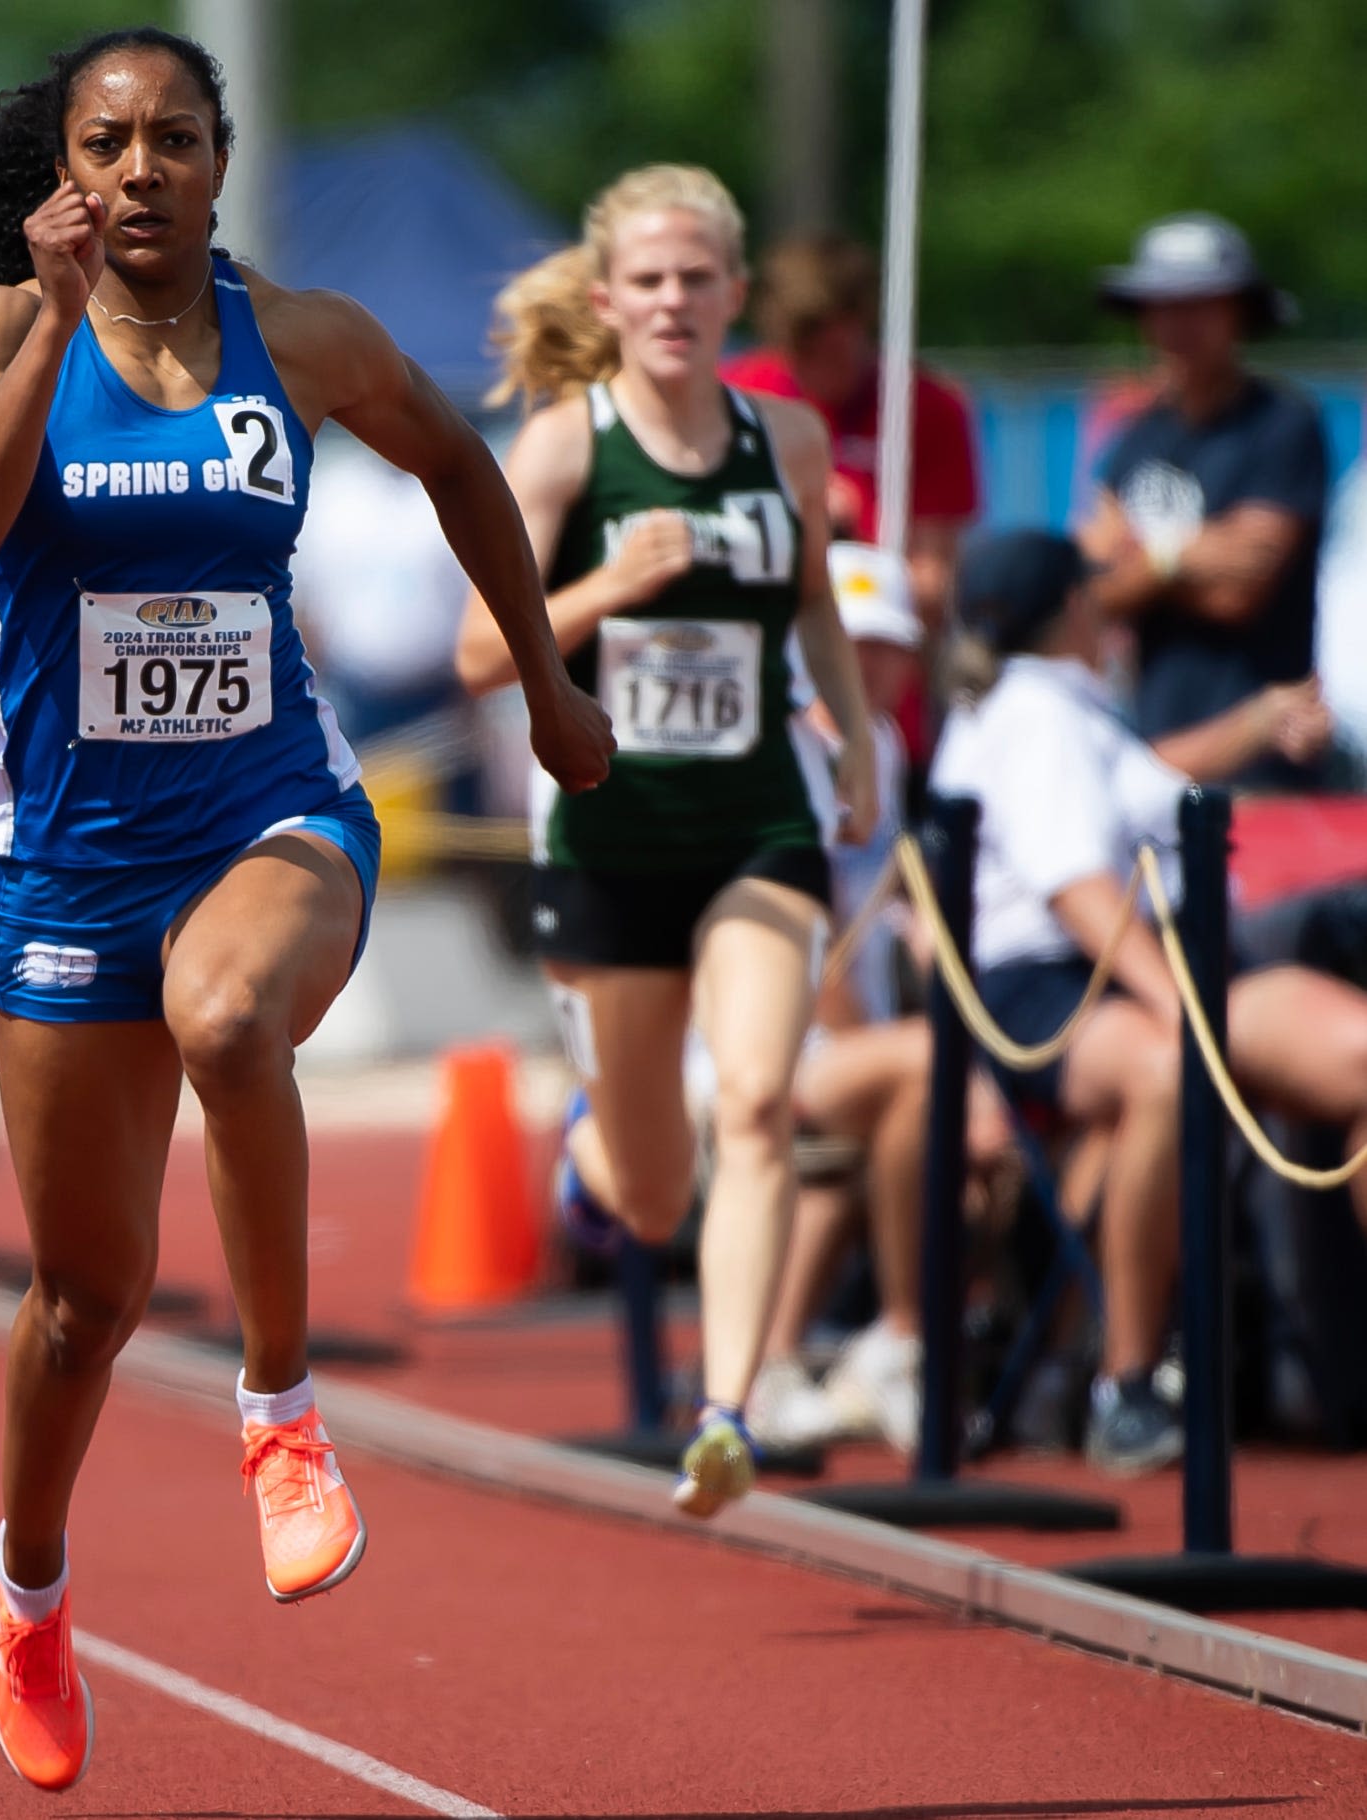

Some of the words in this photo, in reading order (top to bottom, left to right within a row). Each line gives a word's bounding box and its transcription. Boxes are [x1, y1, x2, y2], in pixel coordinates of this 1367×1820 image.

[230, 410, 285, 497] 2
[62, 460, 190, 498] SPRING
[745, 496, 772, 574] 1
[148, 600, 215, 624] PIAA
[103, 631, 144, 644] 2024
[146, 631, 197, 644] TRACK
[200, 631, 211, 644] &
[214, 630, 252, 643] FIELD
[114, 643, 242, 657] CHAMPIONSHIPS
[103, 657, 251, 716] 1975
[628, 677, 745, 729] 1716
[148, 717, 233, 735] ATHLETIC
